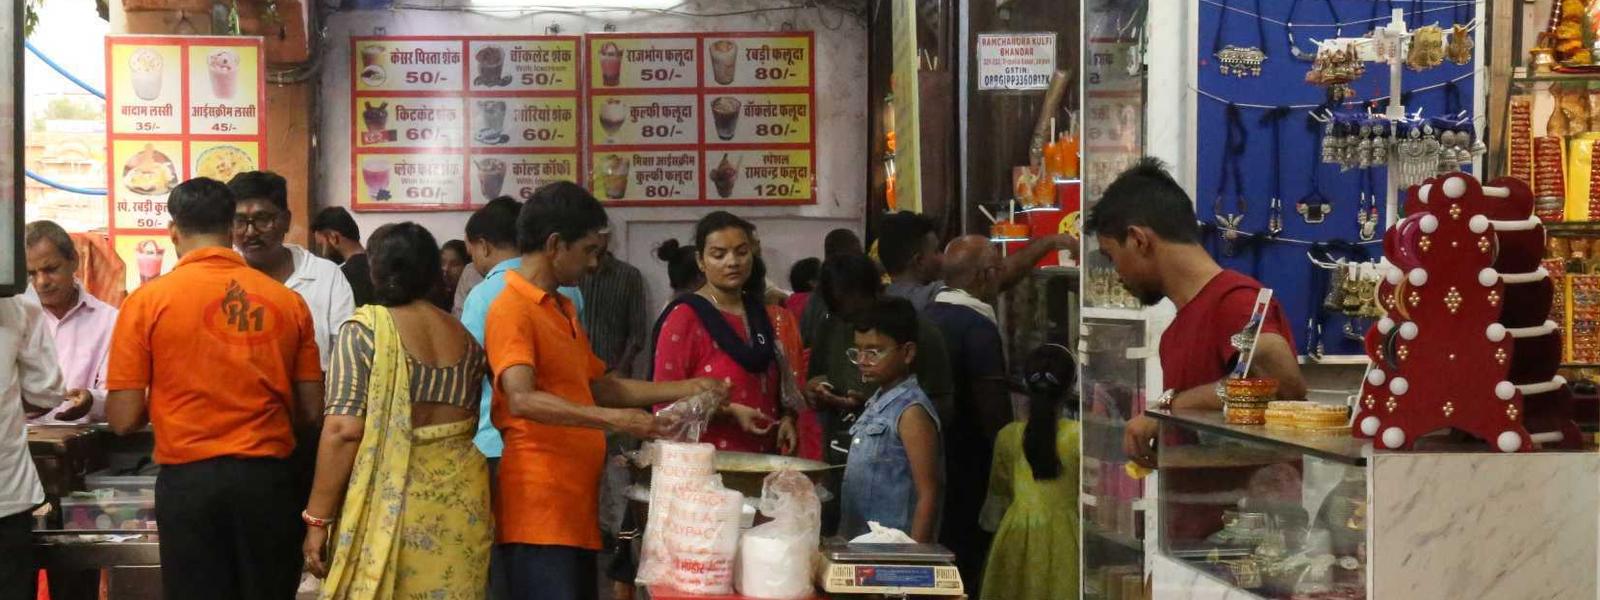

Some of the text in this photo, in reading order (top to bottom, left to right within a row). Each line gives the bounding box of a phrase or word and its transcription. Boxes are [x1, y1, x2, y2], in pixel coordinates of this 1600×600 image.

[1032, 37, 1052, 46] KULFI
[441, 48, 463, 65] शेक
[551, 46, 572, 62] शेक
[664, 48, 694, 66] फलूदा
[772, 48, 804, 65] फलूदा
[1000, 47, 1034, 56] BHANDAR
[405, 71, 447, 84] 50/-
[521, 73, 563, 85] 50/-
[641, 69, 682, 81] 50/-
[755, 67, 797, 80] 80/-
[121, 103, 173, 117] बादाम लस्सी
[234, 104, 256, 117] लस्सी
[551, 105, 573, 121] शेक
[629, 102, 692, 122] कुल्फी फलूदा
[779, 104, 807, 121] फलूदा
[136, 122, 160, 131] 35/-
[211, 123, 237, 131] 45/-
[642, 125, 683, 137] 80/-
[756, 124, 797, 136] 80/-
[406, 128, 447, 140] 60/-
[522, 128, 564, 141] 60/-
[635, 167, 693, 185] कुल्फी फलूदा
[779, 166, 808, 182] फलूदा
[406, 186, 447, 198] 60/-
[645, 185, 681, 197] 80/-
[754, 184, 802, 196] 120/-
[137, 218, 163, 227] 50/-
